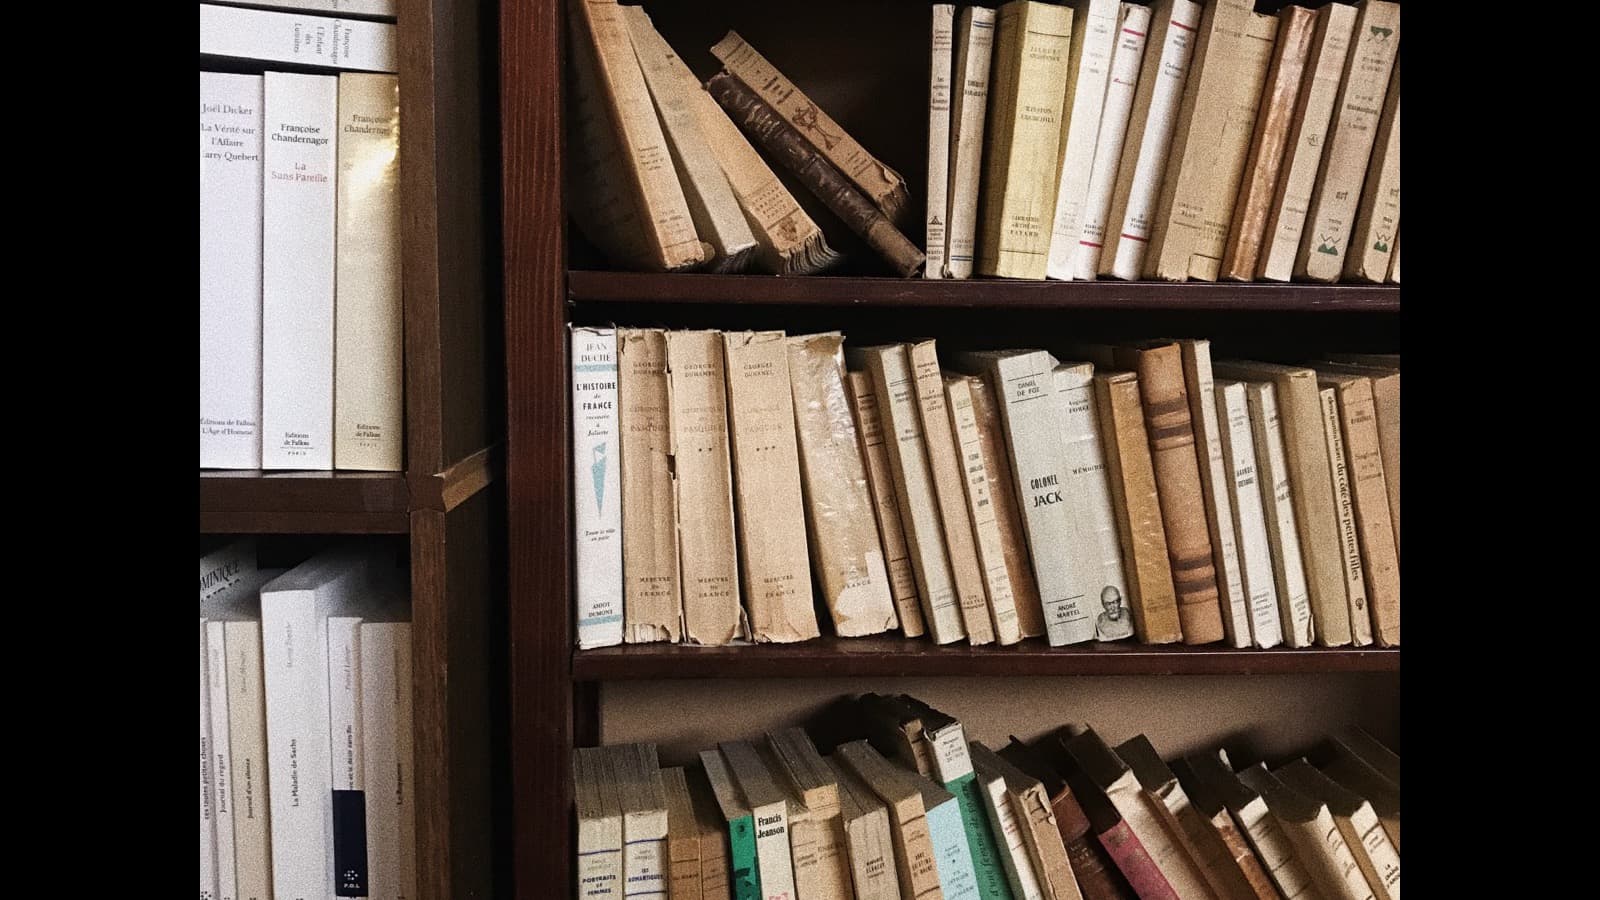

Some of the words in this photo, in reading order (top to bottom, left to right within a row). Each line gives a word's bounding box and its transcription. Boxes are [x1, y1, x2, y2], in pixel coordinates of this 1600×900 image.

[202, 103, 222, 115] Joël
[223, 105, 253, 116] Dicker
[201, 123, 212, 132] La
[214, 123, 241, 134] Vérité
[242, 127, 256, 135] sur
[280, 123, 321, 134] Françoise
[271, 133, 329, 145] Chandernagor
[200, 152, 222, 162] arry
[224, 152, 260, 162] Quebert
[295, 162, 306, 170] La
[271, 171, 294, 181] Sans
[295, 172, 328, 183] Pareille
[585, 342, 609, 351] JEAN
[576, 382, 617, 391] L'HISTOIRE
[1017, 380, 1037, 390] DANIEL
[1028, 386, 1040, 395] FOE
[582, 401, 613, 411] FRANCE
[1337, 463, 1346, 476] du
[1030, 474, 1059, 491] COLONEL
[1339, 476, 1349, 498] côté
[1033, 490, 1064, 508] JACK
[1342, 499, 1352, 518] des
[1343, 519, 1355, 555] petites
[1349, 554, 1361, 581] filles
[200, 560, 241, 591] MINIQUE
[765, 589, 796, 599] FRANCE
[1057, 602, 1077, 611] ANDRÉ
[588, 609, 613, 618] DUMONT
[1056, 610, 1081, 619] MARTEL
[217, 754, 226, 777] regard
[291, 759, 297, 768] de
[219, 788, 227, 813] Journal
[292, 798, 299, 807] La
[757, 813, 783, 827] Francis
[757, 825, 785, 839] Jeanson
[1385, 863, 1391, 871] LA
[582, 874, 617, 884] PORTRAITS
[587, 888, 612, 897] FEMMES
